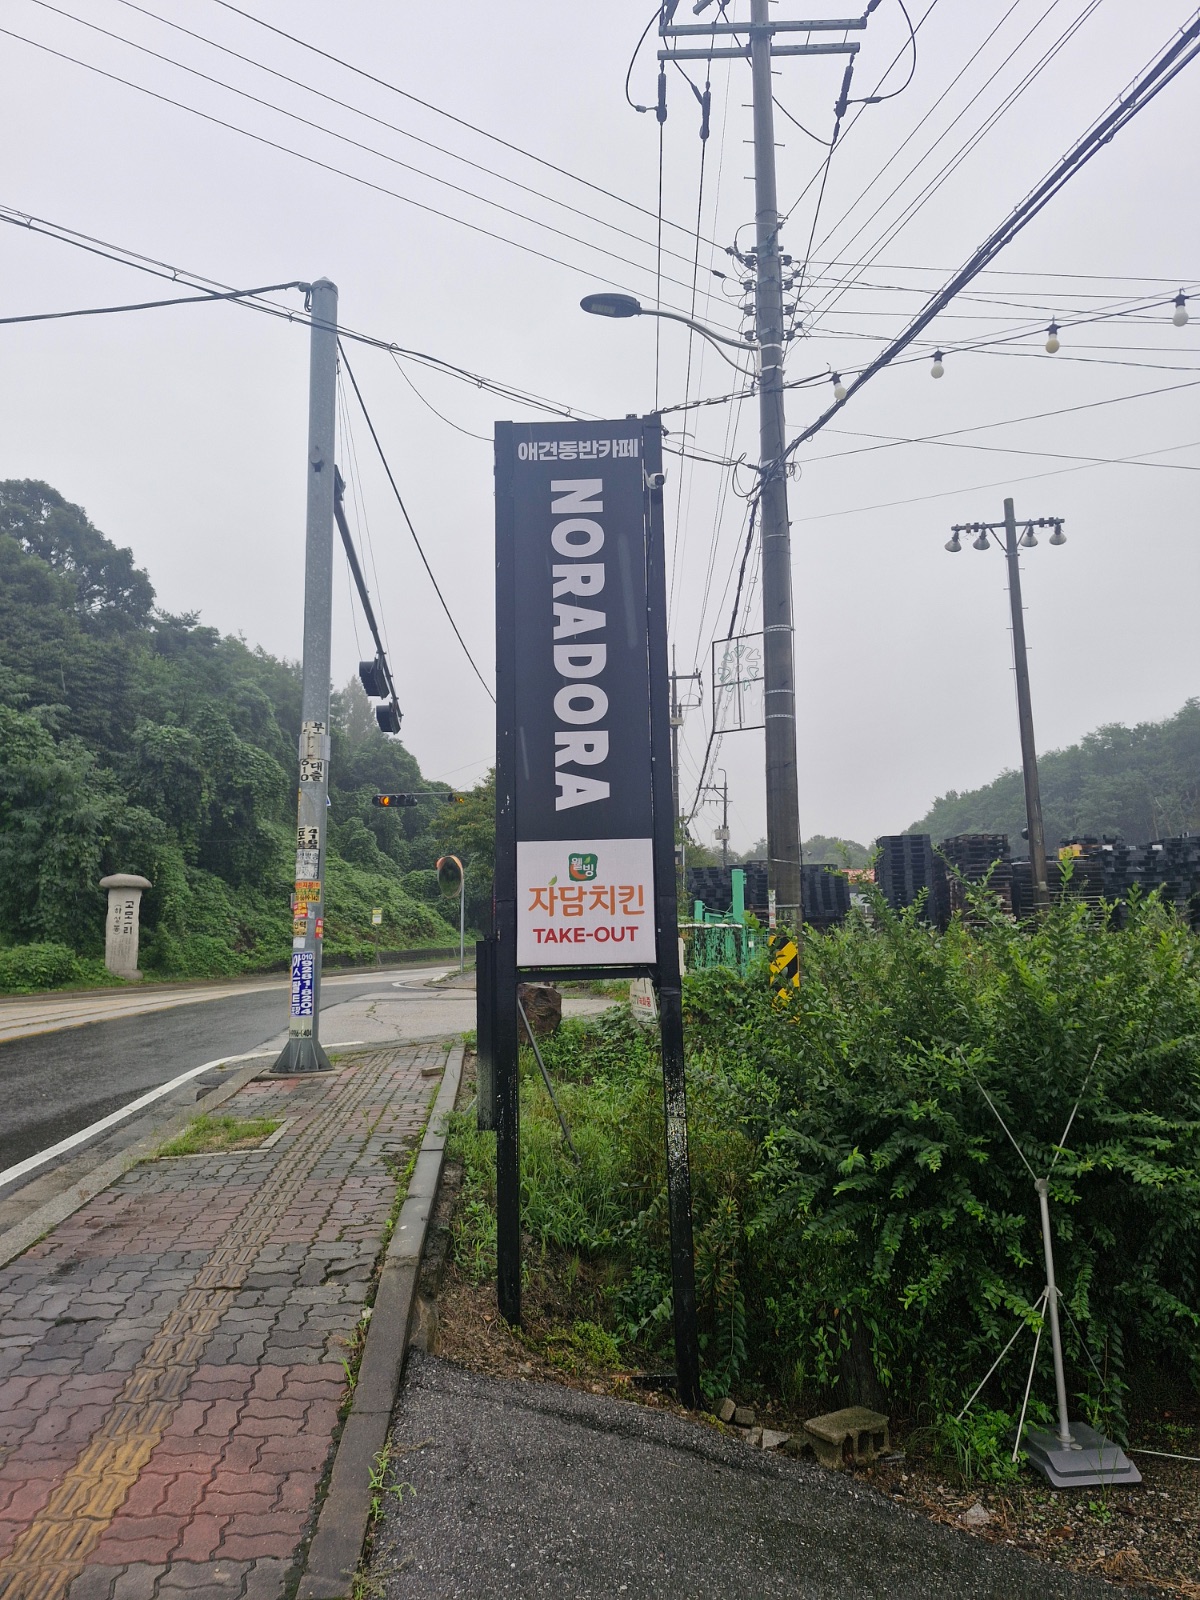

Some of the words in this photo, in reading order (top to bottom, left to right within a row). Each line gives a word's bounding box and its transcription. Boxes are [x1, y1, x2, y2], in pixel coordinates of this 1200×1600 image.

[518, 438, 639, 461] 애견동반카페
[551, 478, 610, 812] NORADORA
[571, 857, 594, 877] 웰빙
[528, 884, 645, 917] 자담치킨
[532, 926, 639, 943] TAKE-OUT
